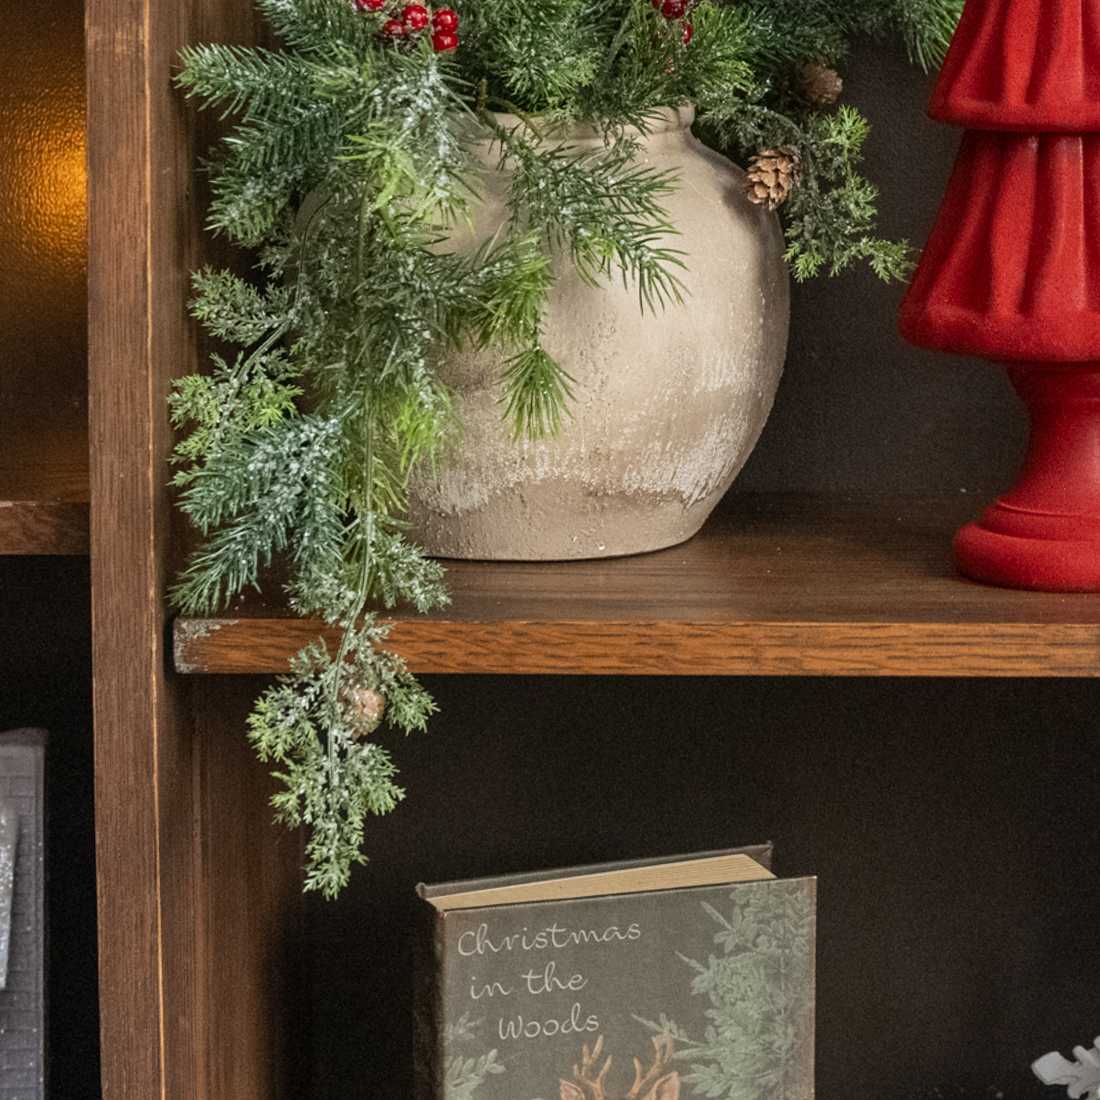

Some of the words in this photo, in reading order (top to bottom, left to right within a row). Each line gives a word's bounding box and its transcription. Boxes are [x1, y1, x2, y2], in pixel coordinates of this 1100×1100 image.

[457, 923, 641, 956] Christmas
[470, 976, 513, 1000] in
[521, 961, 588, 995] the
[499, 1002, 599, 1040] Woods
